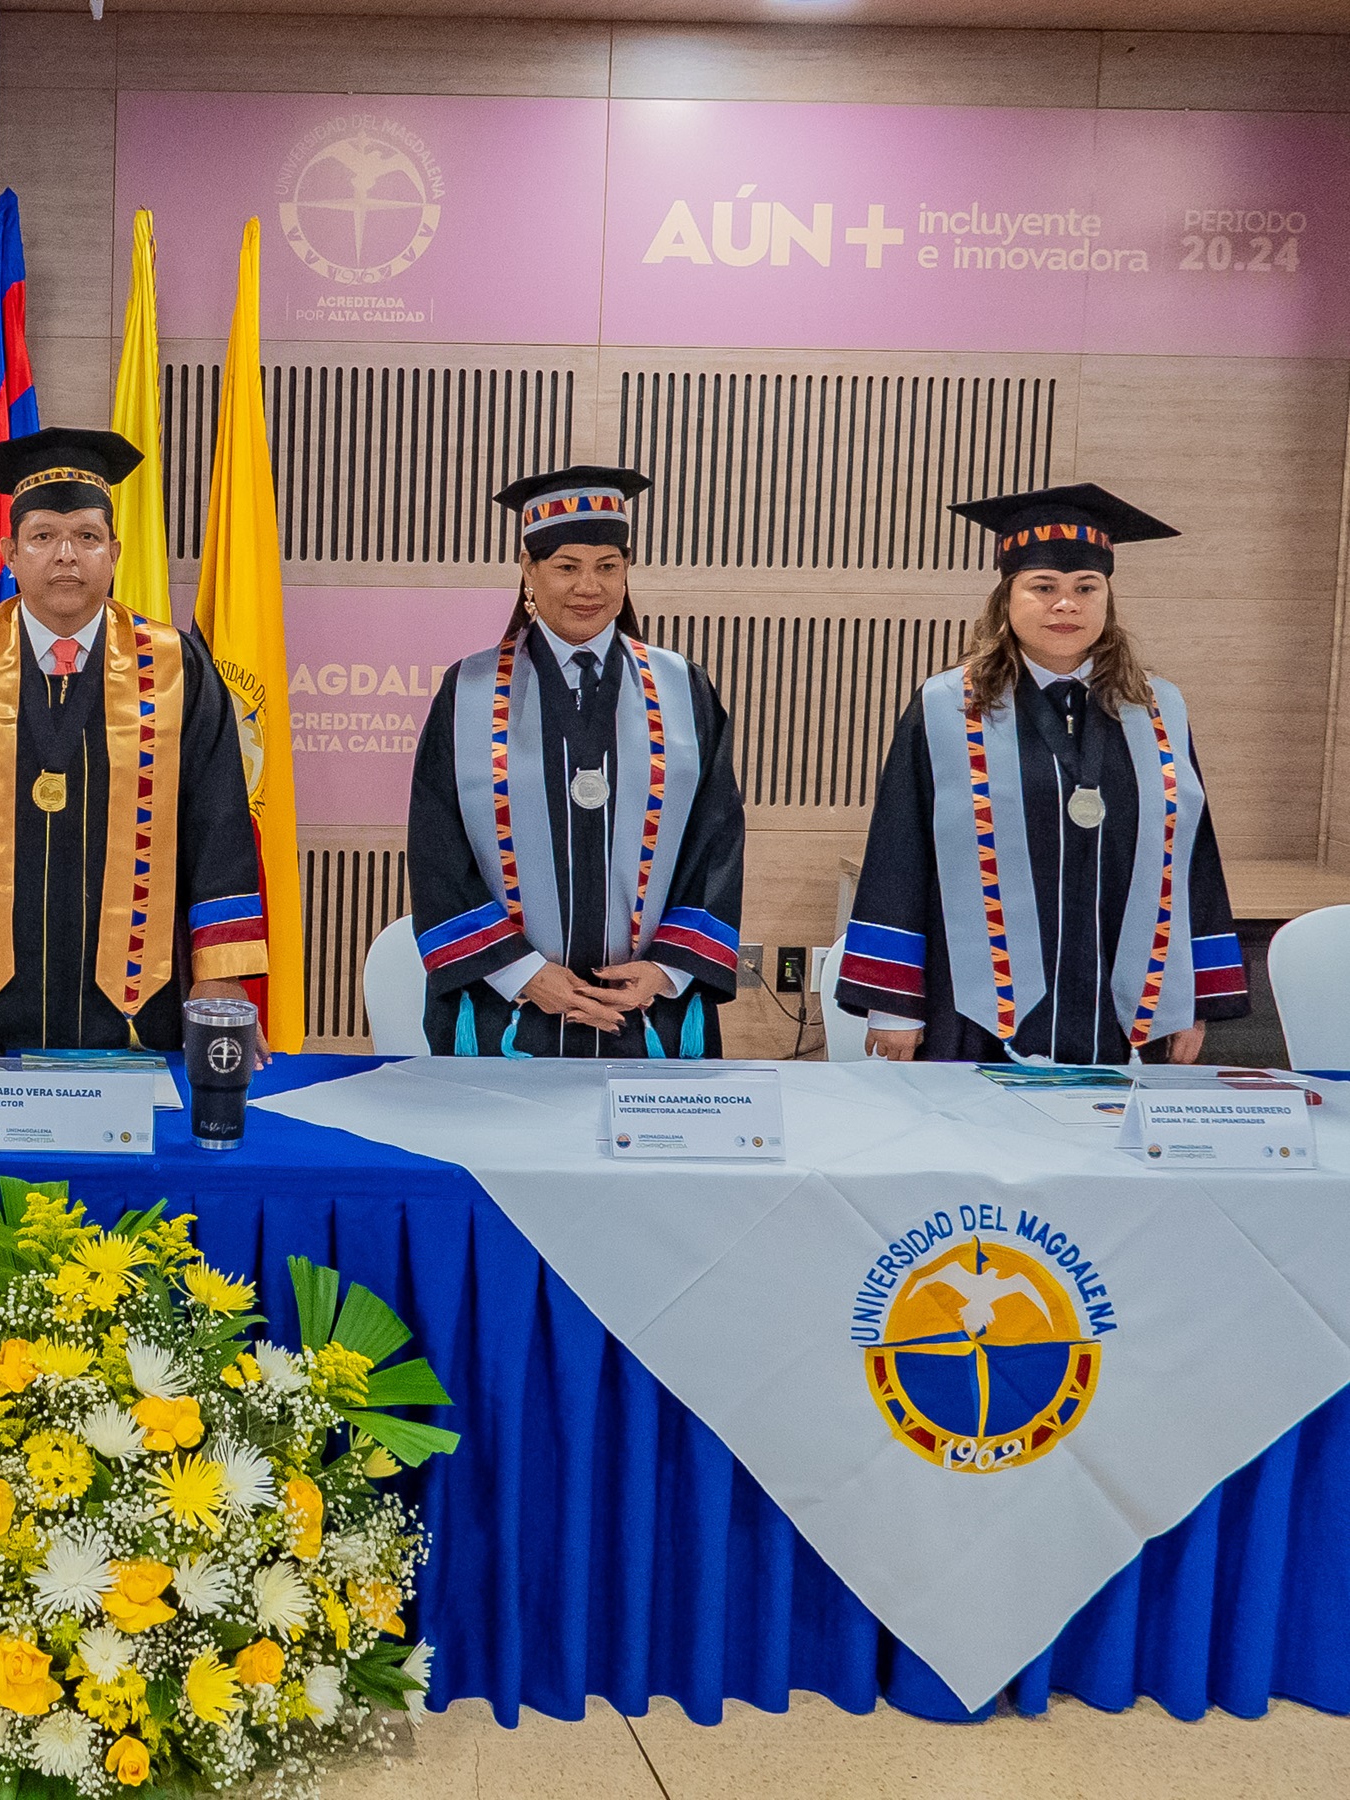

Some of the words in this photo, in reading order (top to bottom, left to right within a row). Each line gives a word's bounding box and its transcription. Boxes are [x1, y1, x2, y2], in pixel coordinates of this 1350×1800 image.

[274, 116, 347, 196] UNIVERSIDAD
[351, 114, 378, 130] DEL
[381, 118, 446, 200] MAGDALENA
[641, 184, 833, 267] AÚN
[918, 202, 1102, 246] incluyente
[1184, 210, 1308, 234] PERIODO
[917, 245, 938, 269] e
[953, 238, 1149, 272] innovadora
[1179, 236, 1301, 272] 20.24
[296, 309, 323, 321] POR
[327, 310, 360, 321] ALTA
[363, 311, 425, 322] CALIDAD
[317, 296, 405, 308] ACREDITADA
[213, 659, 256, 692] RSIDAD
[290, 713, 416, 731] CREDITADA
[292, 735, 343, 751] ALTA
[347, 736, 416, 753] CALID
[26, 1088, 53, 1097] VERA
[56, 1089, 102, 1098] SALAZAR
[618, 1093, 656, 1103] LEYNÍN
[658, 1094, 712, 1104] CAAMAÑO
[714, 1096, 752, 1104] ROCHA
[1150, 1106, 1183, 1114] LAURA
[1186, 1106, 1233, 1114] MORALES
[1235, 1106, 1291, 1115] GUERRERO
[851, 1211, 954, 1342] UNIVERSIDAD
[959, 1204, 1008, 1232] DEL
[1016, 1210, 1118, 1336] MAGDALENA
[942, 1438, 1023, 1471] 1962
